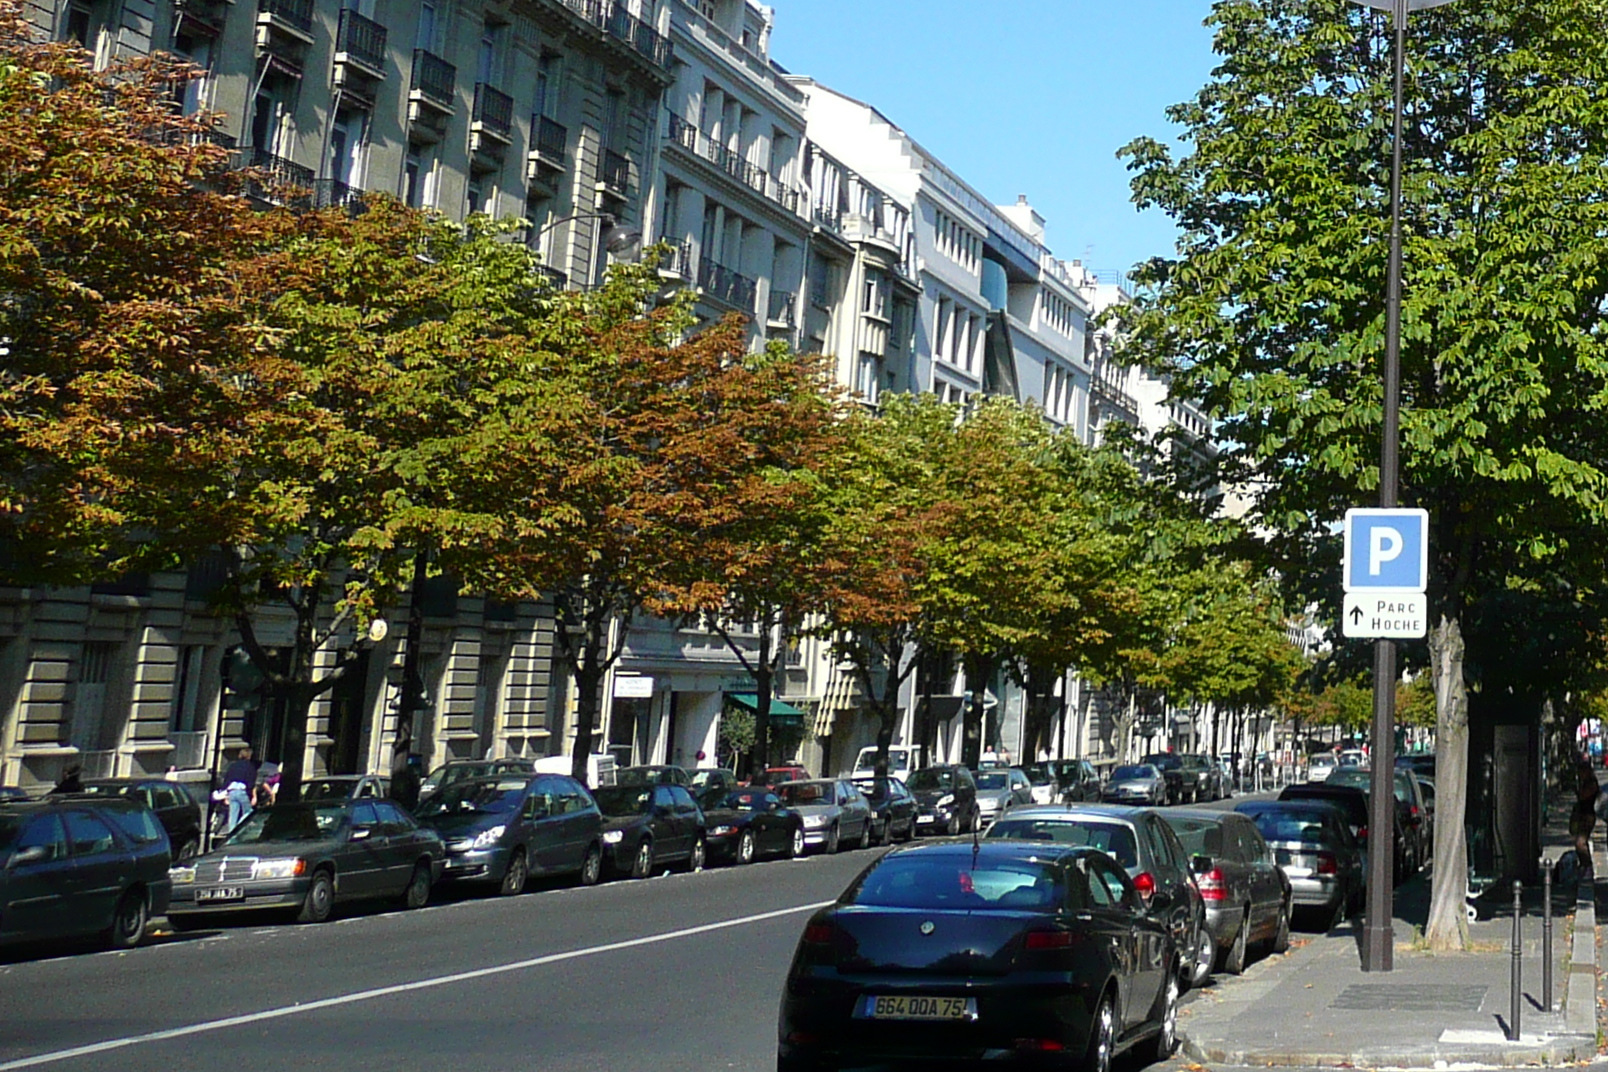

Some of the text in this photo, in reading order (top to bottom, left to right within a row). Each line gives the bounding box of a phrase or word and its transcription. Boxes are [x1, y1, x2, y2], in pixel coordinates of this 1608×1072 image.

[1369, 526, 1403, 576] P
[1377, 600, 1415, 613] PARC
[1372, 618, 1420, 631] HOCHE
[875, 997, 905, 1015] 664
[942, 999, 962, 1017] 75
